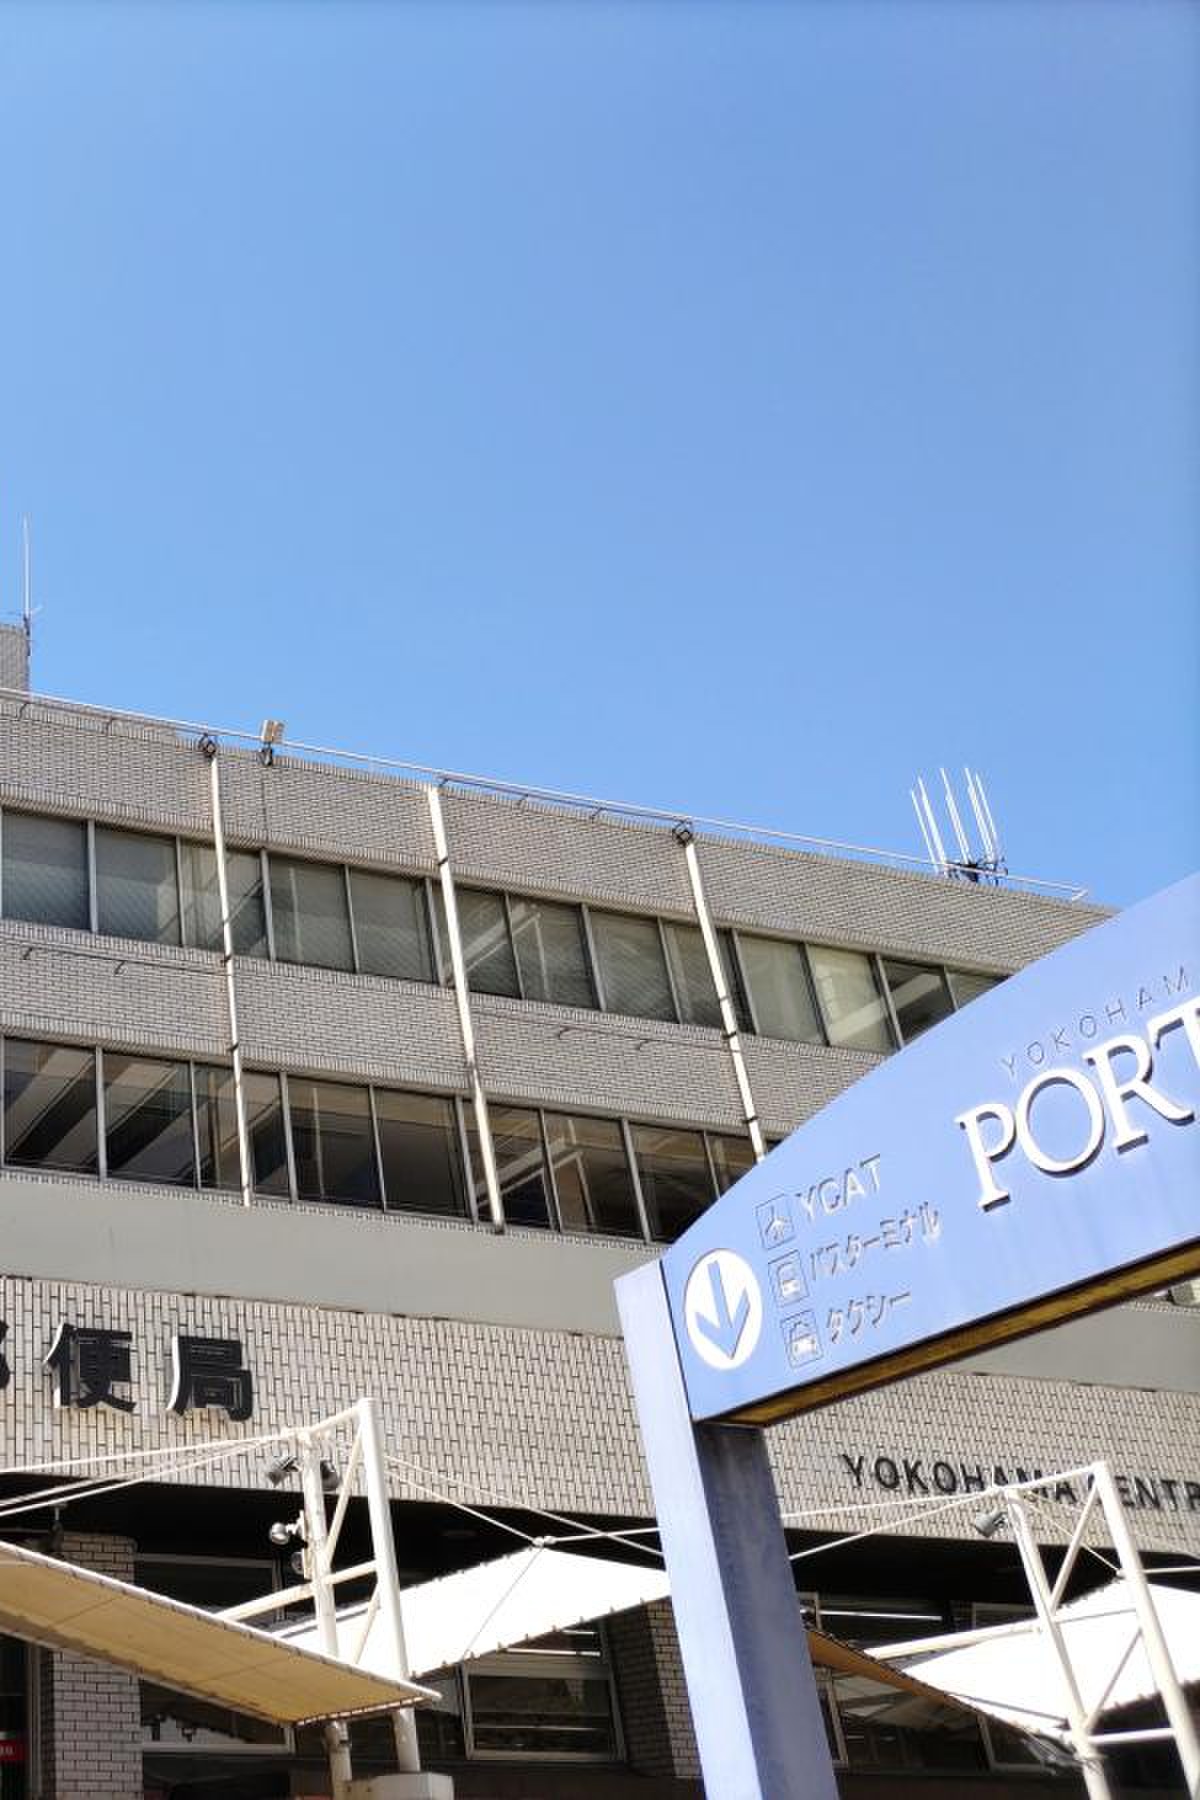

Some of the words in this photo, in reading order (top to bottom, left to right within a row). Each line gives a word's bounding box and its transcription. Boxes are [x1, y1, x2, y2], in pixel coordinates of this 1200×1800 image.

[795, 1153, 883, 1222] YCAT
[810, 1200, 942, 1281] バスターミナル
[826, 1291, 911, 1344] タクシー
[1087, 1472, 1200, 1512] ENTR
